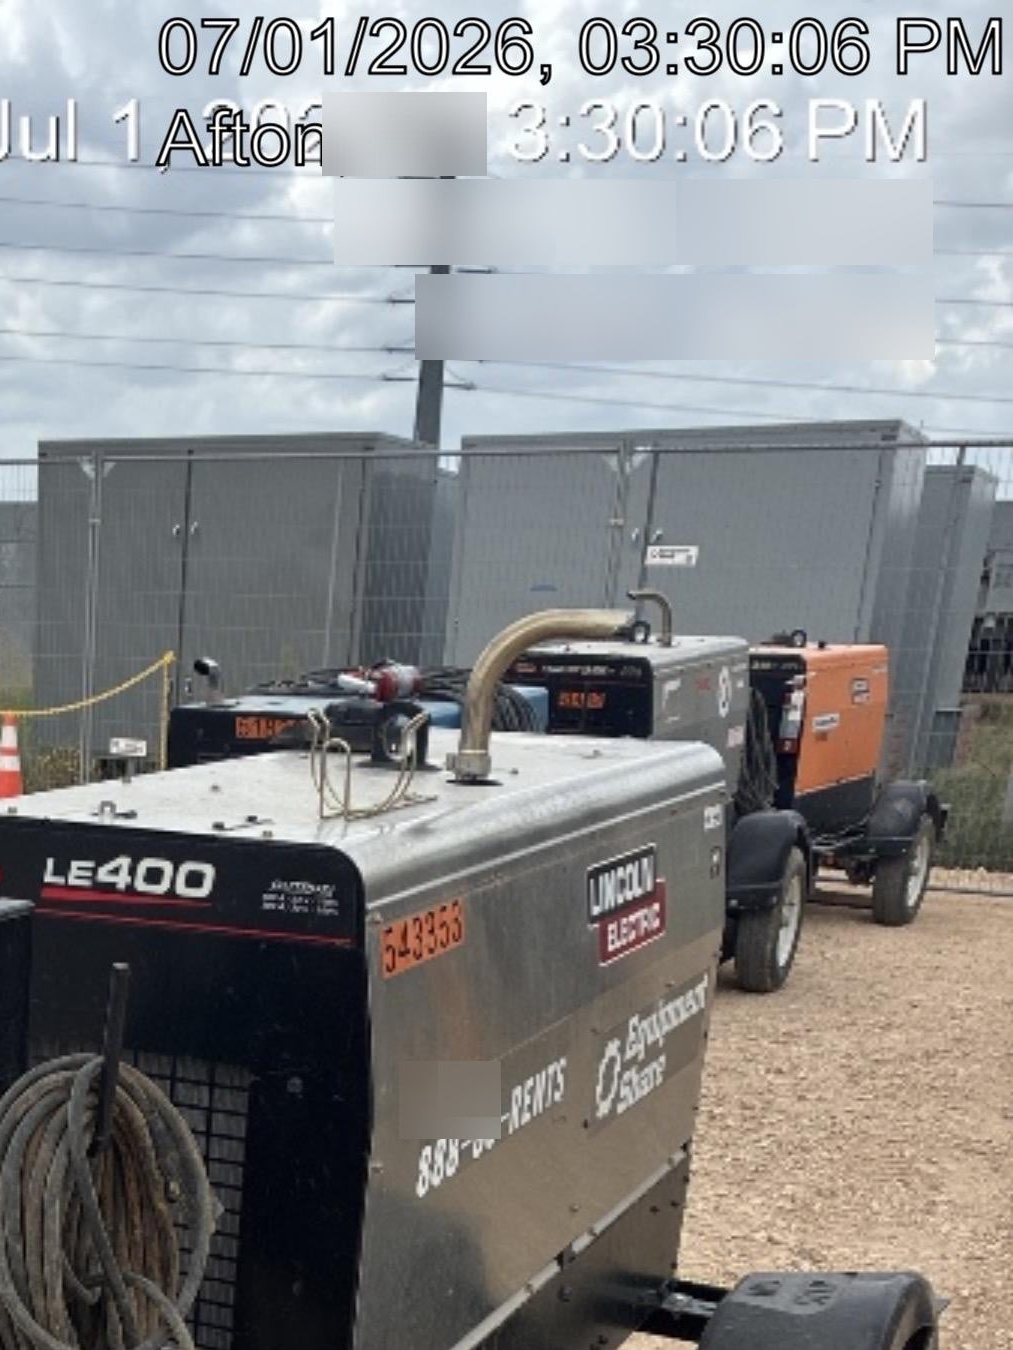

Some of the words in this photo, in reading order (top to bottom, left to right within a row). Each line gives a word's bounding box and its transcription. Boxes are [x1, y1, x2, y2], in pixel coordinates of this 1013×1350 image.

[42, 855, 217, 898] LE400
[589, 854, 656, 917] LINCOLN
[384, 899, 464, 974] 543353
[606, 902, 661, 953] ELECTRIC
[616, 1054, 668, 1115] Share
